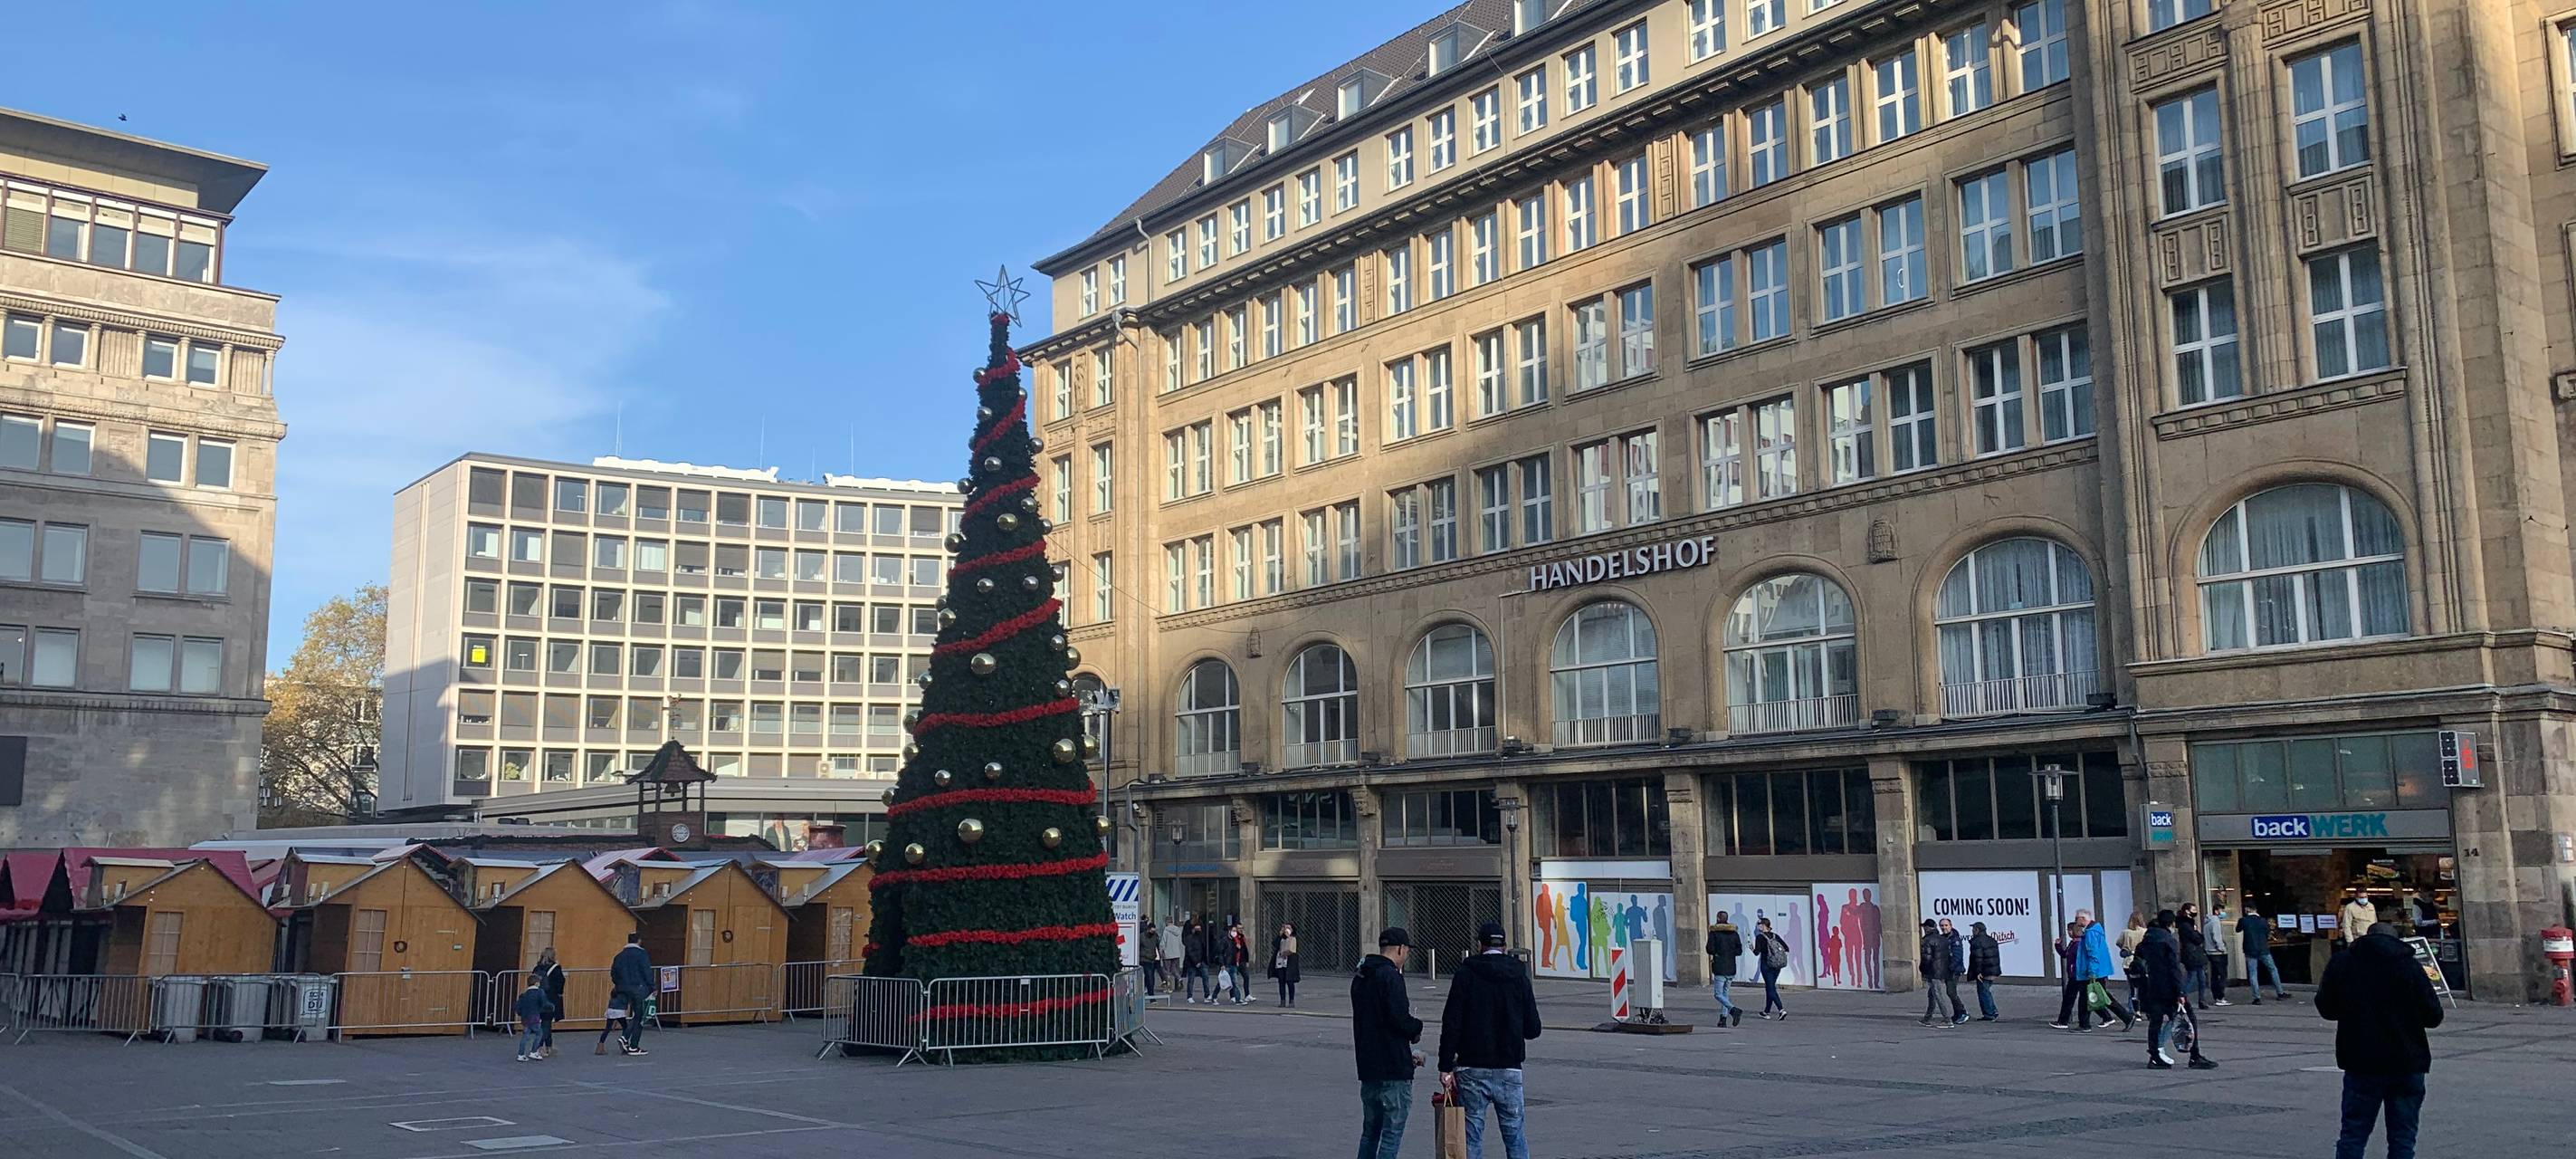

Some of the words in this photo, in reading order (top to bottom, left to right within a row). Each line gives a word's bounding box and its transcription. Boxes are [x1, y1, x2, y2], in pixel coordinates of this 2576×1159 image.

[1531, 536, 1715, 589] HANDELSHOF
[2151, 813, 2172, 826] back
[1933, 898, 1983, 915] COMING
[1987, 898, 2029, 915] SOON!
